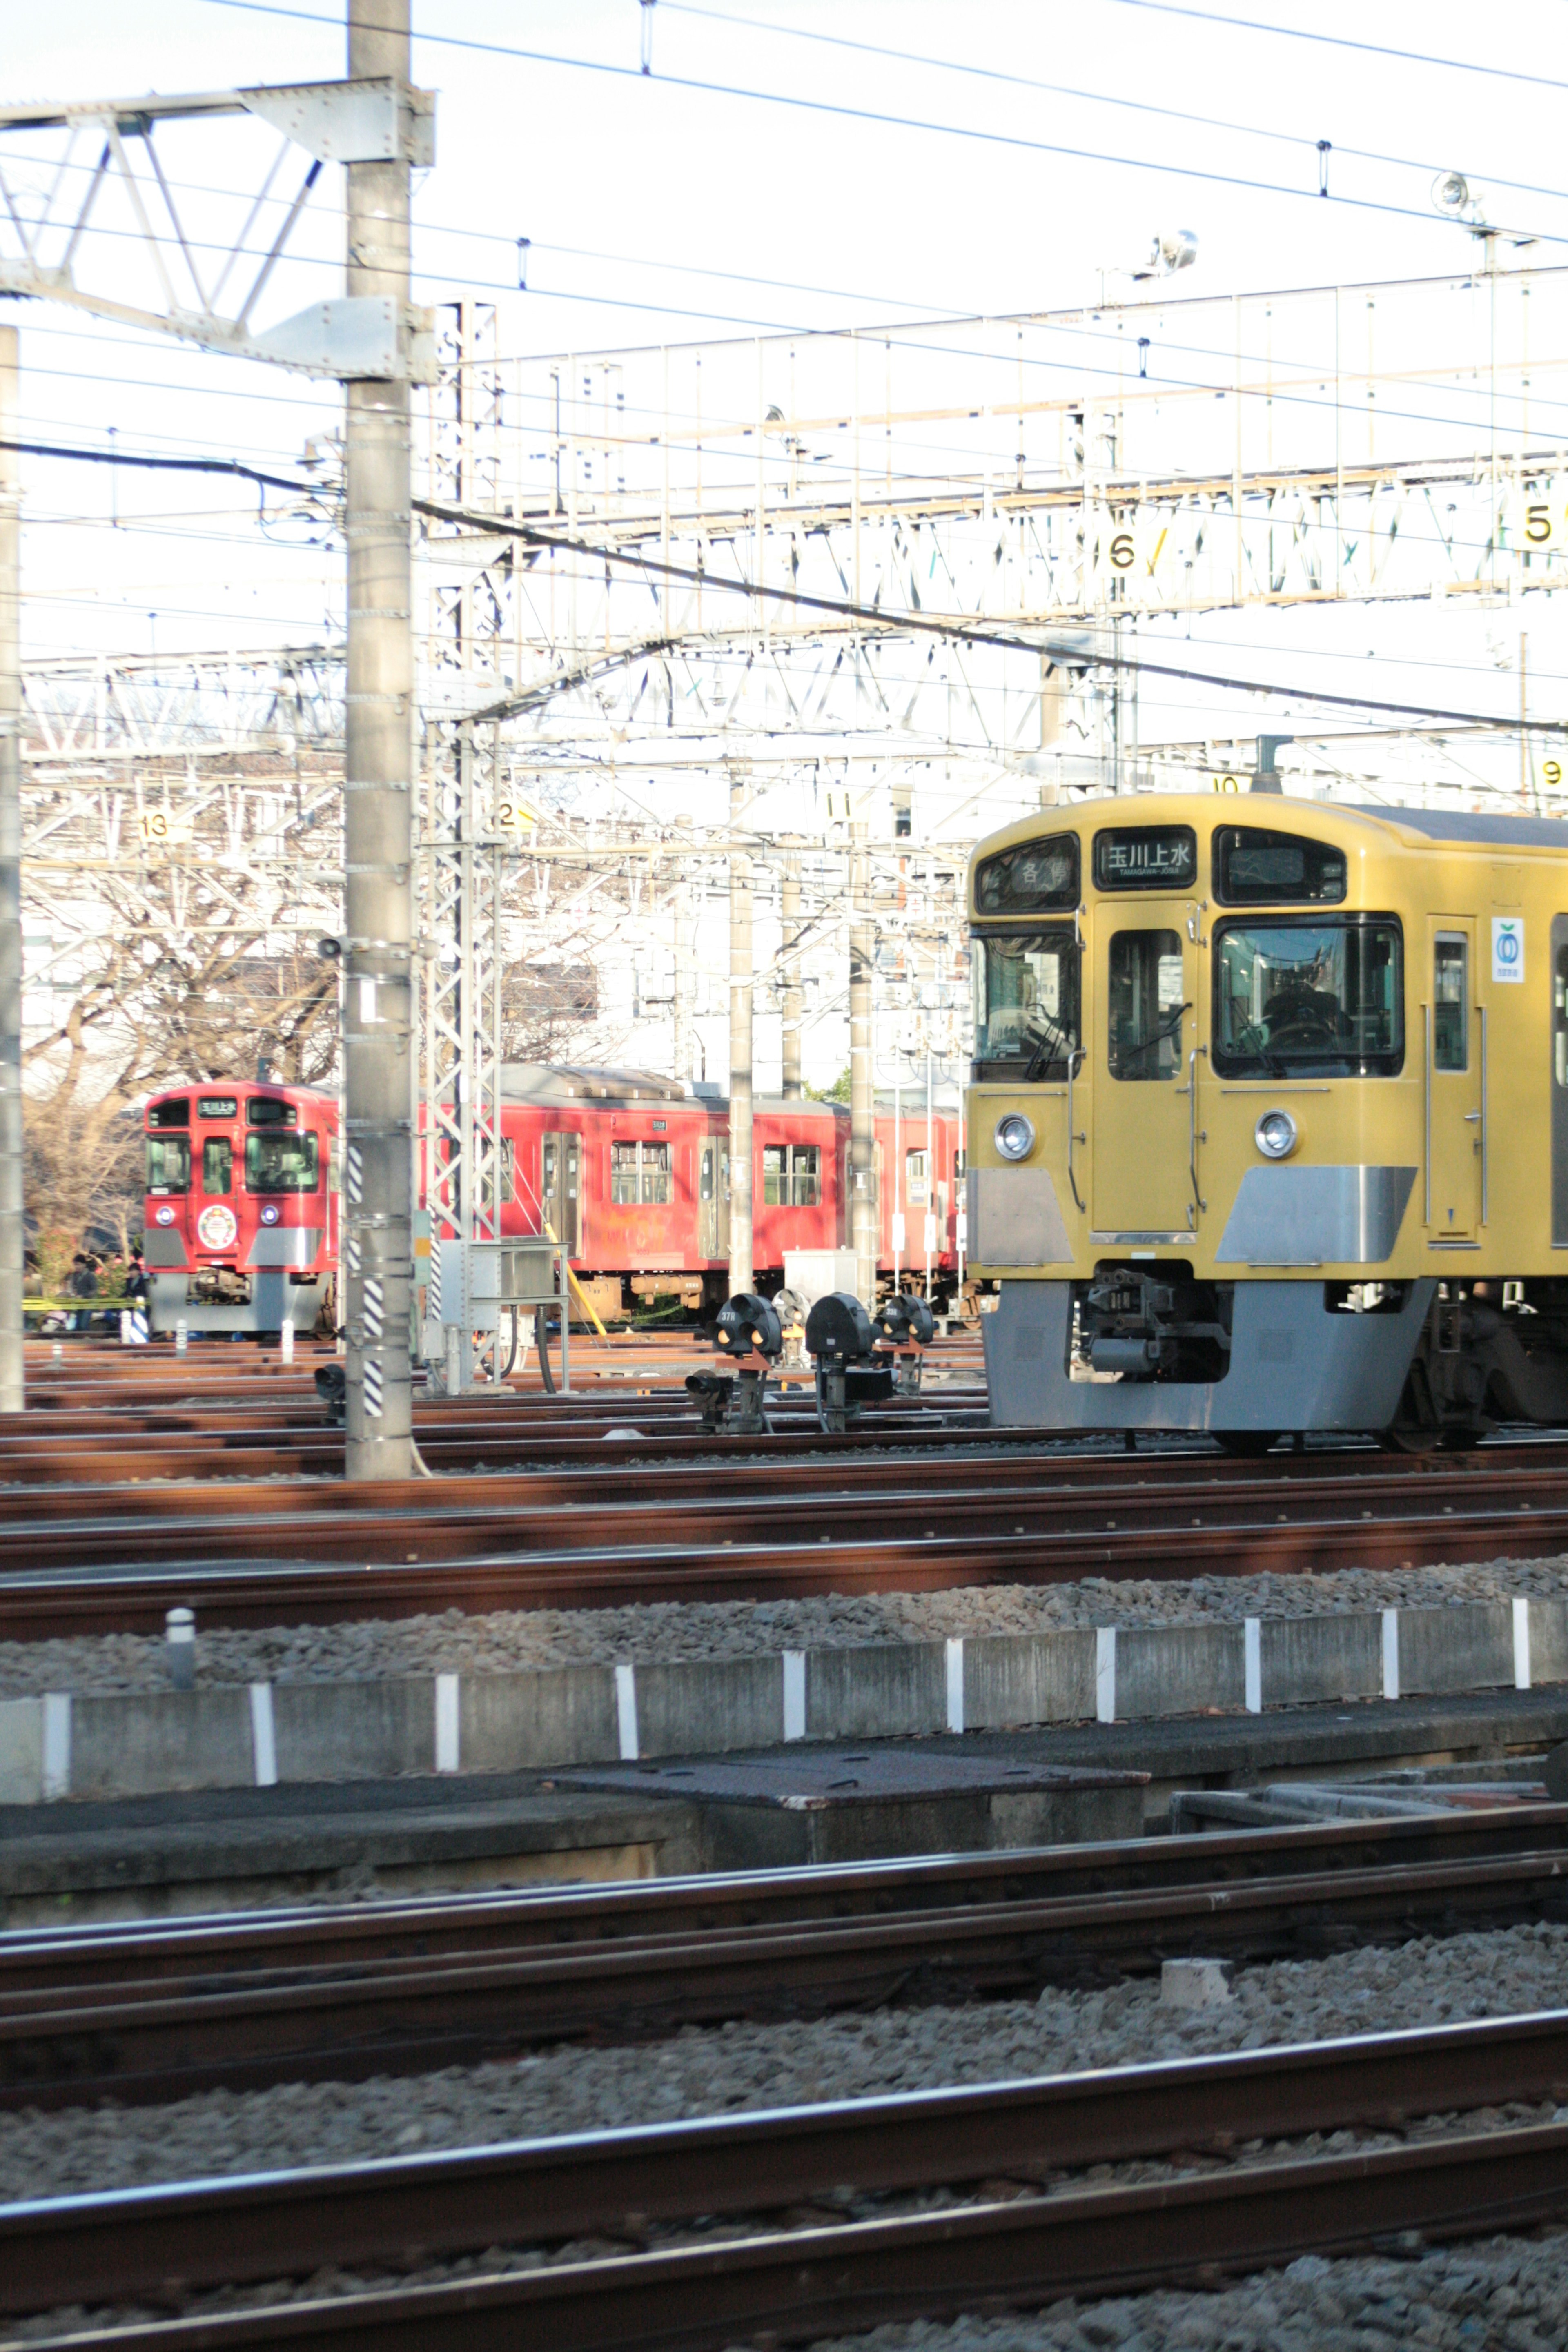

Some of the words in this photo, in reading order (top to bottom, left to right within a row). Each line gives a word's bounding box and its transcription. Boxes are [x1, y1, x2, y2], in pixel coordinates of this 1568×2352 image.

[1525, 505, 1551, 543] 5
[1109, 534, 1134, 568] 6
[1543, 761, 1561, 784] 9
[1214, 776, 1238, 793] 10
[827, 793, 850, 817] 11
[143, 814, 167, 836] 13
[1108, 843, 1190, 868] 玉川上水
[722, 1312, 735, 1321] 37R
